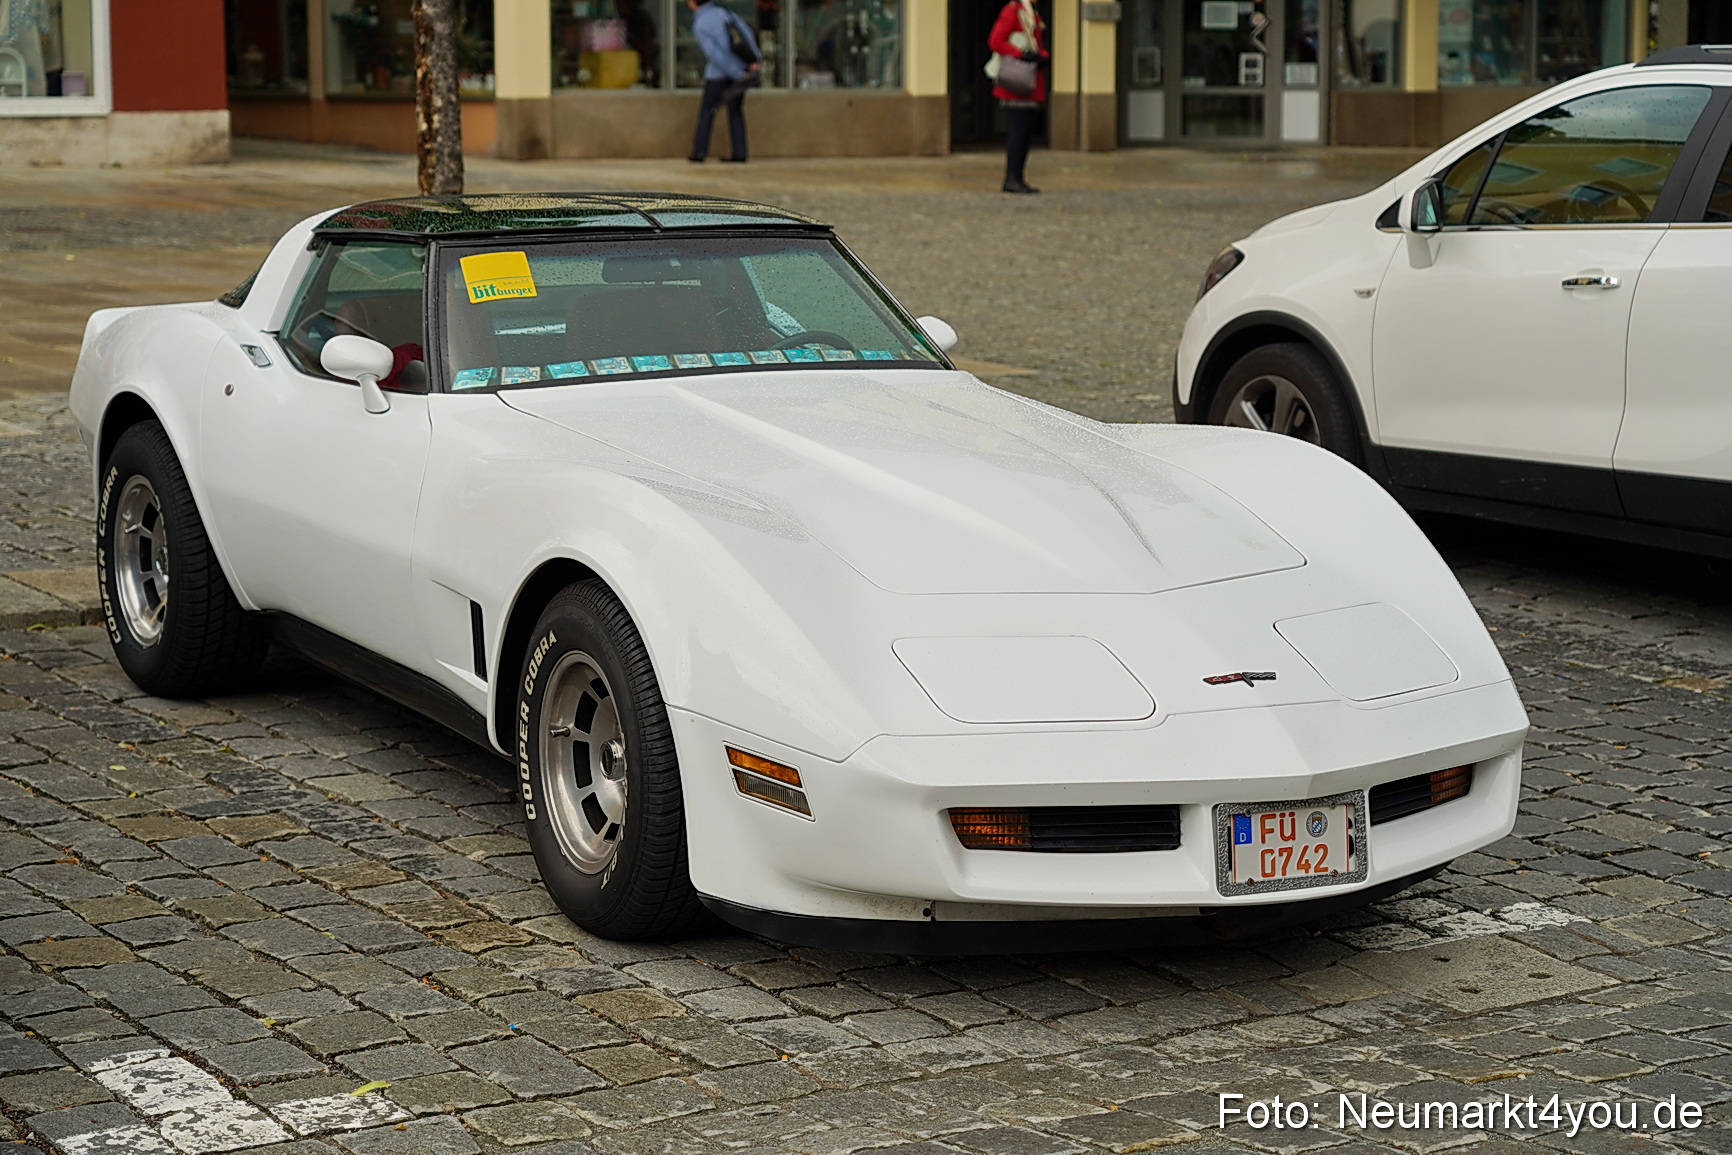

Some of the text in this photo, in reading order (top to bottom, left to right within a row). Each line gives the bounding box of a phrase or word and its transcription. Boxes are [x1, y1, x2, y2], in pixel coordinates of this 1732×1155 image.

[98, 465, 121, 645] COOPER COBRA
[519, 629, 558, 821] COOPER COBRA
[1239, 832, 1247, 843] D
[1259, 811, 1296, 844] FÜ
[1260, 843, 1329, 878] 0742
